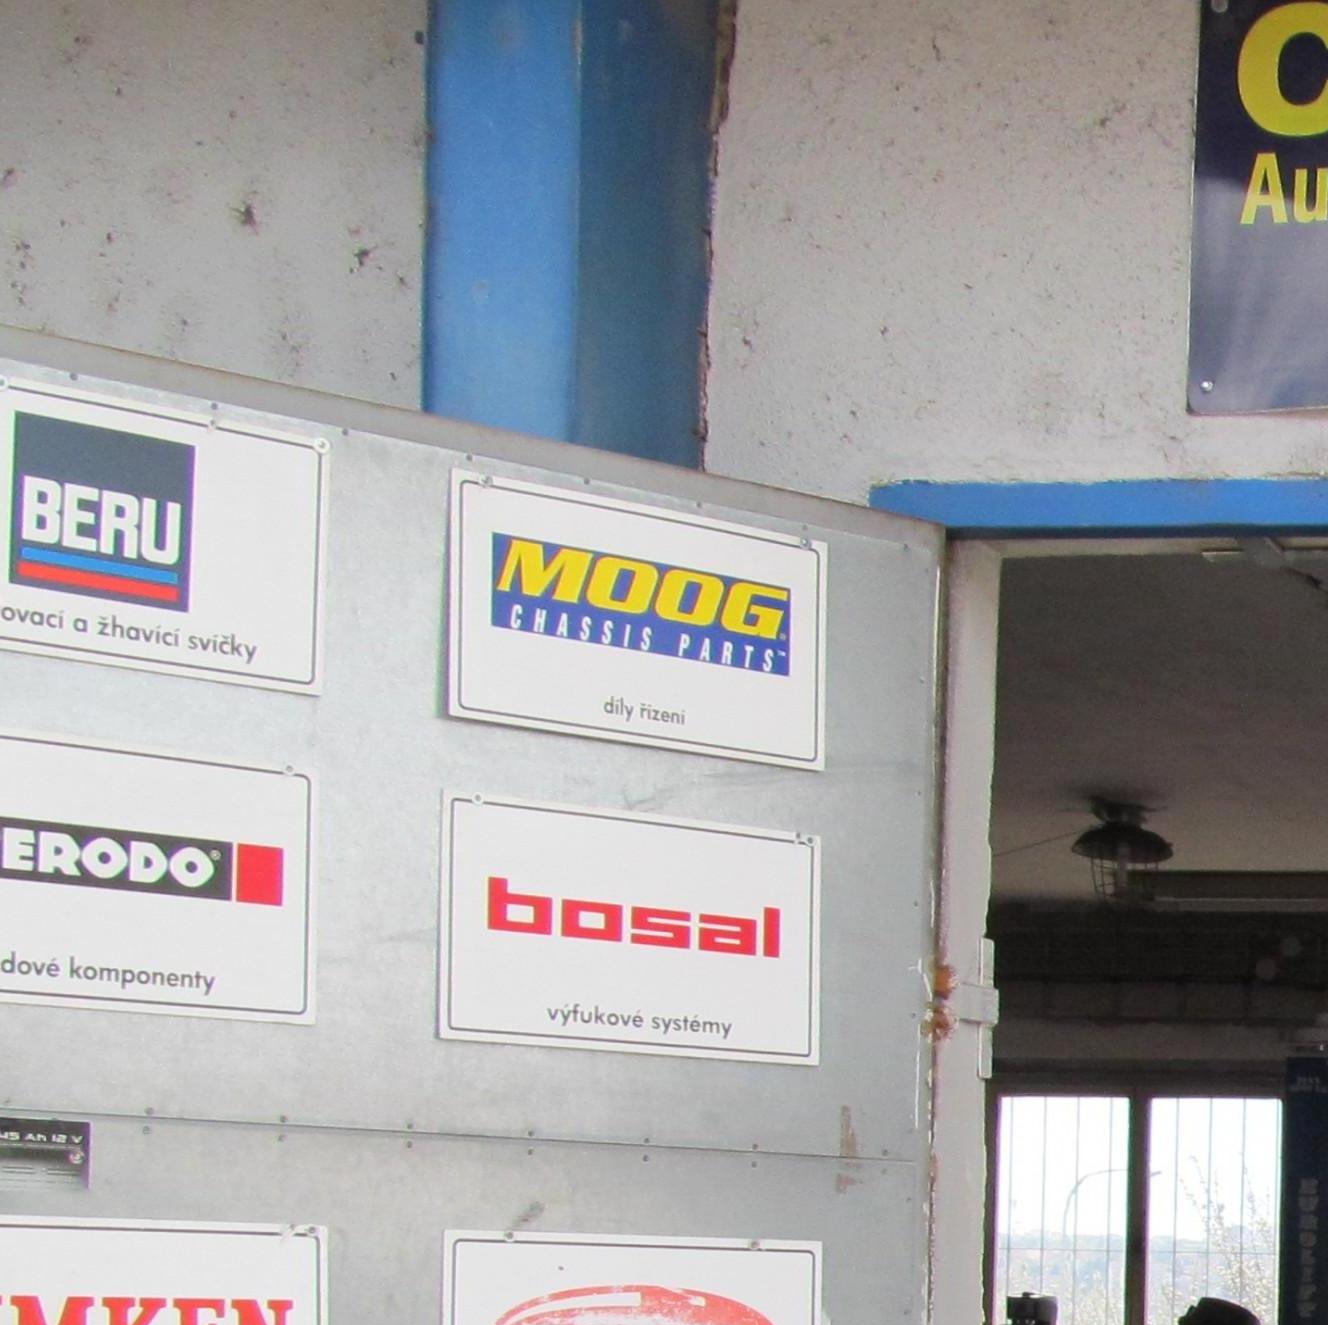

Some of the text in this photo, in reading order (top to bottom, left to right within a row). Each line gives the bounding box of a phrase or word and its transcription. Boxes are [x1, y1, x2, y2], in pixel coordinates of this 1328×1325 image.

[21, 474, 182, 565] BERU
[496, 538, 789, 640] MOOG
[1, 606, 258, 665] ovací a žhavící svíčky
[510, 603, 774, 673] CHASSIS PARTS
[1, 826, 215, 888] ERODO
[487, 876, 781, 959] bosal
[0, 951, 216, 996] dové komponenty
[546, 1002, 733, 1040] výfukové systémy
